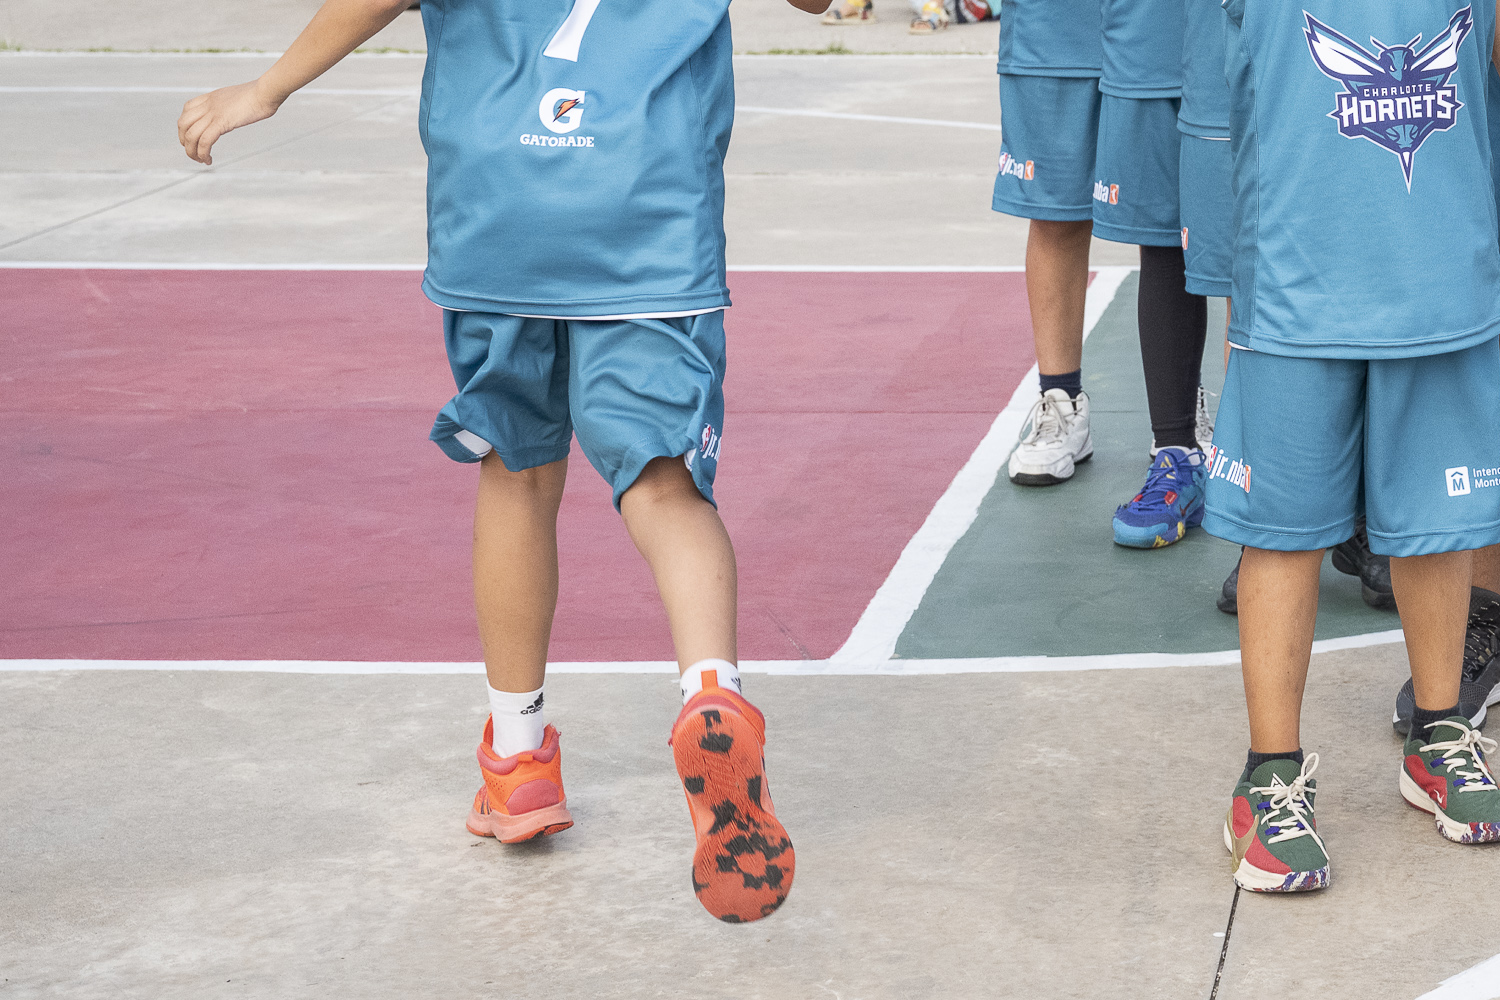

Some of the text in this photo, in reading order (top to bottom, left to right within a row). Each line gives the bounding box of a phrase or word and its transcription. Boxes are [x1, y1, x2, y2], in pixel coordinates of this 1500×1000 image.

[1363, 83, 1432, 97] CHARLOTTE
[1339, 89, 1456, 127] HORNETS
[519, 133, 595, 147] GATORADE
[1092, 179, 1110, 203] nba
